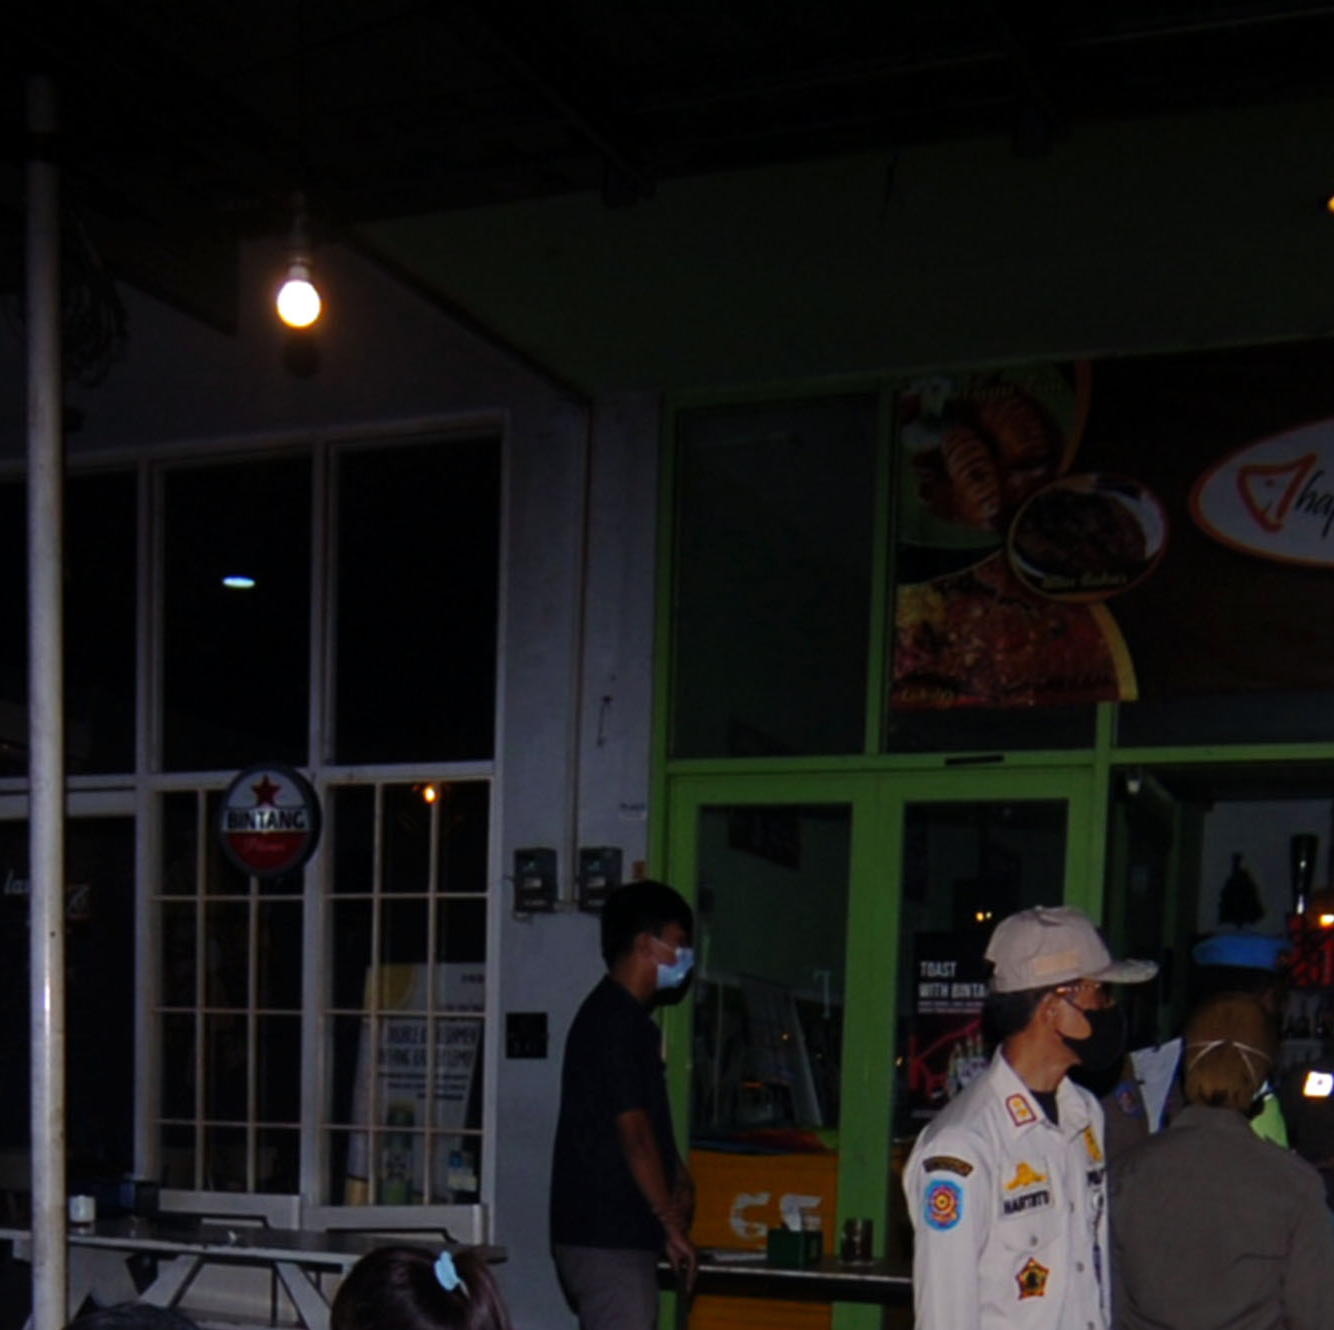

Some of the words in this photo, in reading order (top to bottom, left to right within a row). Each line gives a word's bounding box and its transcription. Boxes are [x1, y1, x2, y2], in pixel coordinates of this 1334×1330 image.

[228, 810, 305, 829] BINTANG
[920, 960, 957, 978] TOAST
[918, 982, 949, 999] WITH
[951, 982, 987, 999] BINTA
